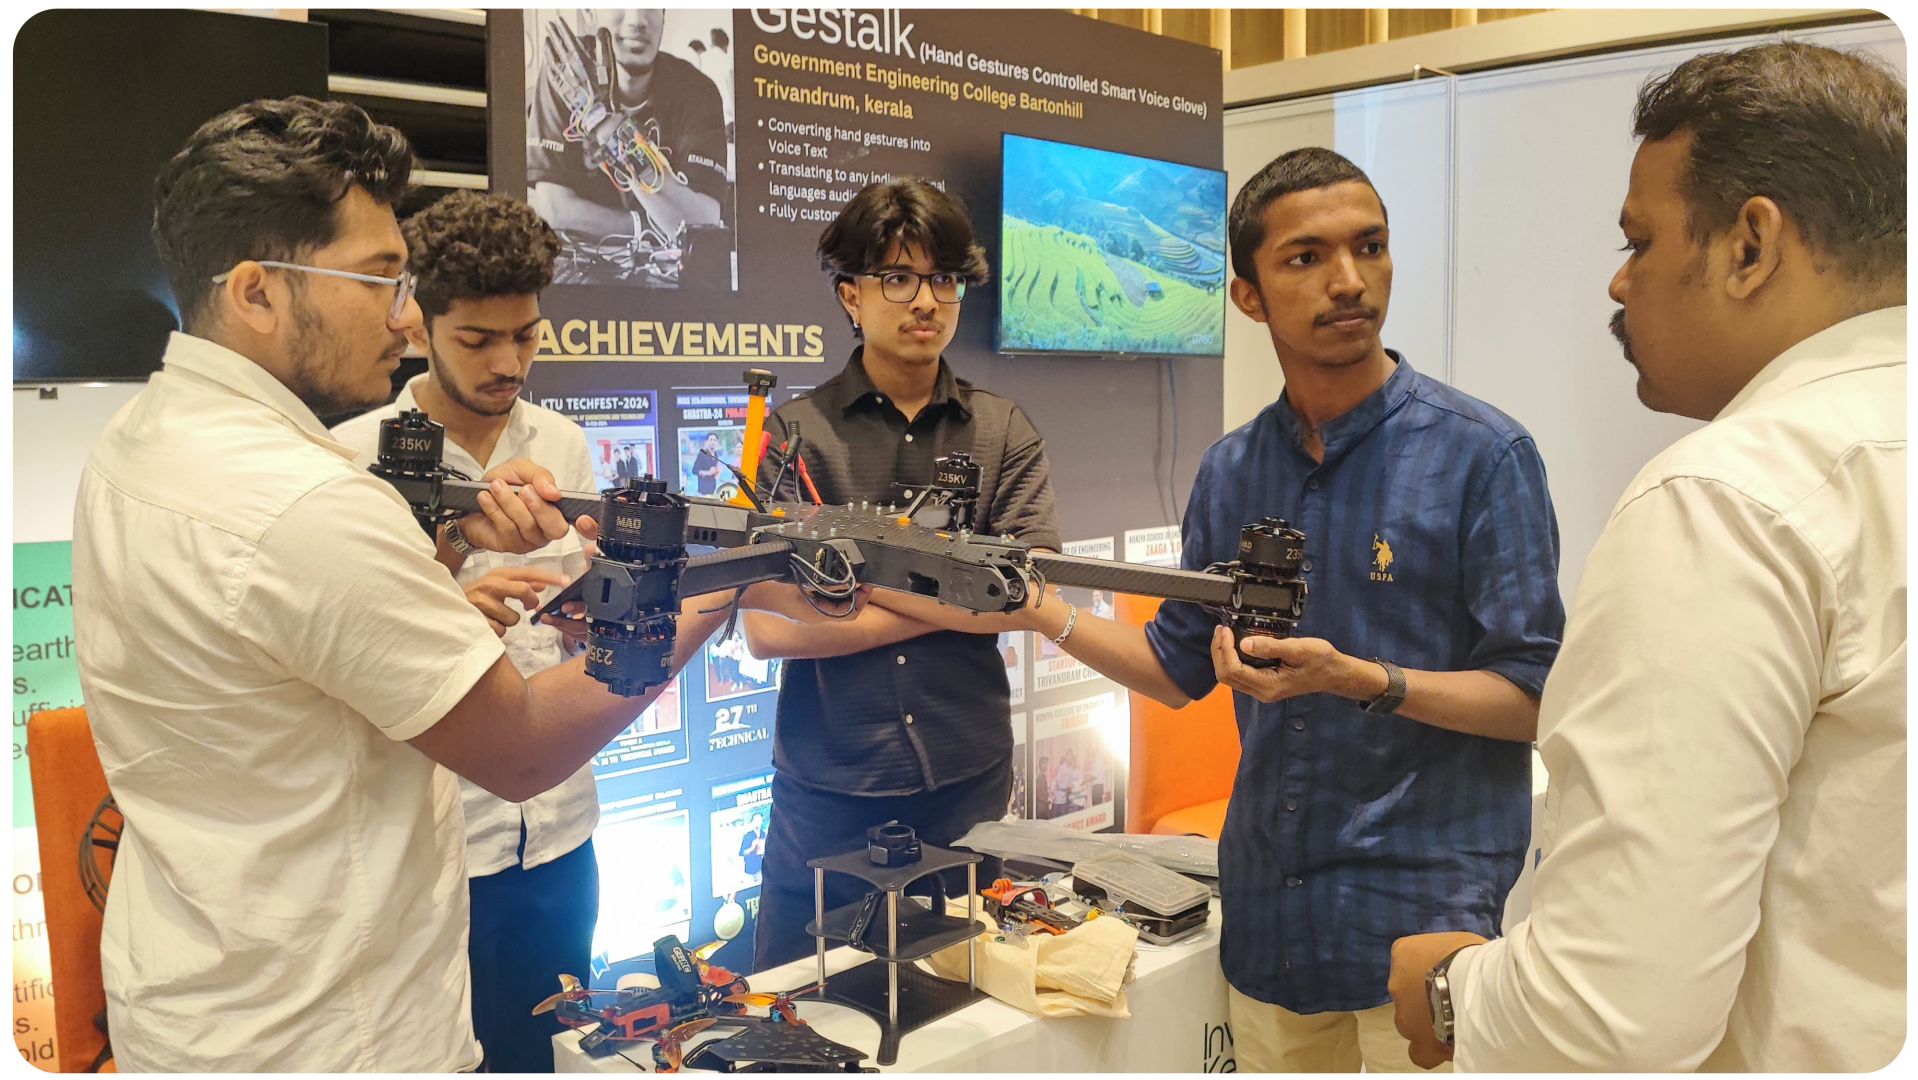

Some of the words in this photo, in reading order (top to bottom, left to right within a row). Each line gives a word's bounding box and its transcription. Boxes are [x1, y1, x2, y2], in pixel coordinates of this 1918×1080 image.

[754, 44, 862, 79] Government
[866, 63, 959, 101] Engineering
[963, 82, 1016, 110] College
[1020, 92, 1084, 118] Bartonhill
[920, 42, 964, 68] (Hand
[967, 53, 1029, 81] Gestures
[1033, 66, 1099, 94] Controlled
[1101, 80, 1137, 102] Smart
[1138, 88, 1170, 109] Voice
[1172, 96, 1208, 120] Glove)
[754, 78, 860, 114] Trivandrum,
[865, 94, 914, 119] kerala
[769, 118, 832, 141] Converting
[834, 126, 862, 142] hand
[864, 131, 909, 148] gestures
[910, 137, 931, 152] into
[769, 139, 801, 155] Voice
[803, 143, 828, 159] Text
[769, 160, 833, 183] Translating
[835, 170, 847, 182] to
[849, 172, 869, 188] any
[769, 181, 827, 203] languages
[769, 203, 798, 222] Fully
[536, 318, 824, 357] ACHIEVEMENTS
[541, 398, 563, 410] KTU
[566, 397, 650, 410] TECHFEST-2024
[392, 437, 432, 452] 235KV
[938, 472, 968, 484] 235KV
[616, 516, 642, 529] MAD
[1370, 572, 1394, 582] USPA
[709, 728, 770, 752] TECHNICAL
